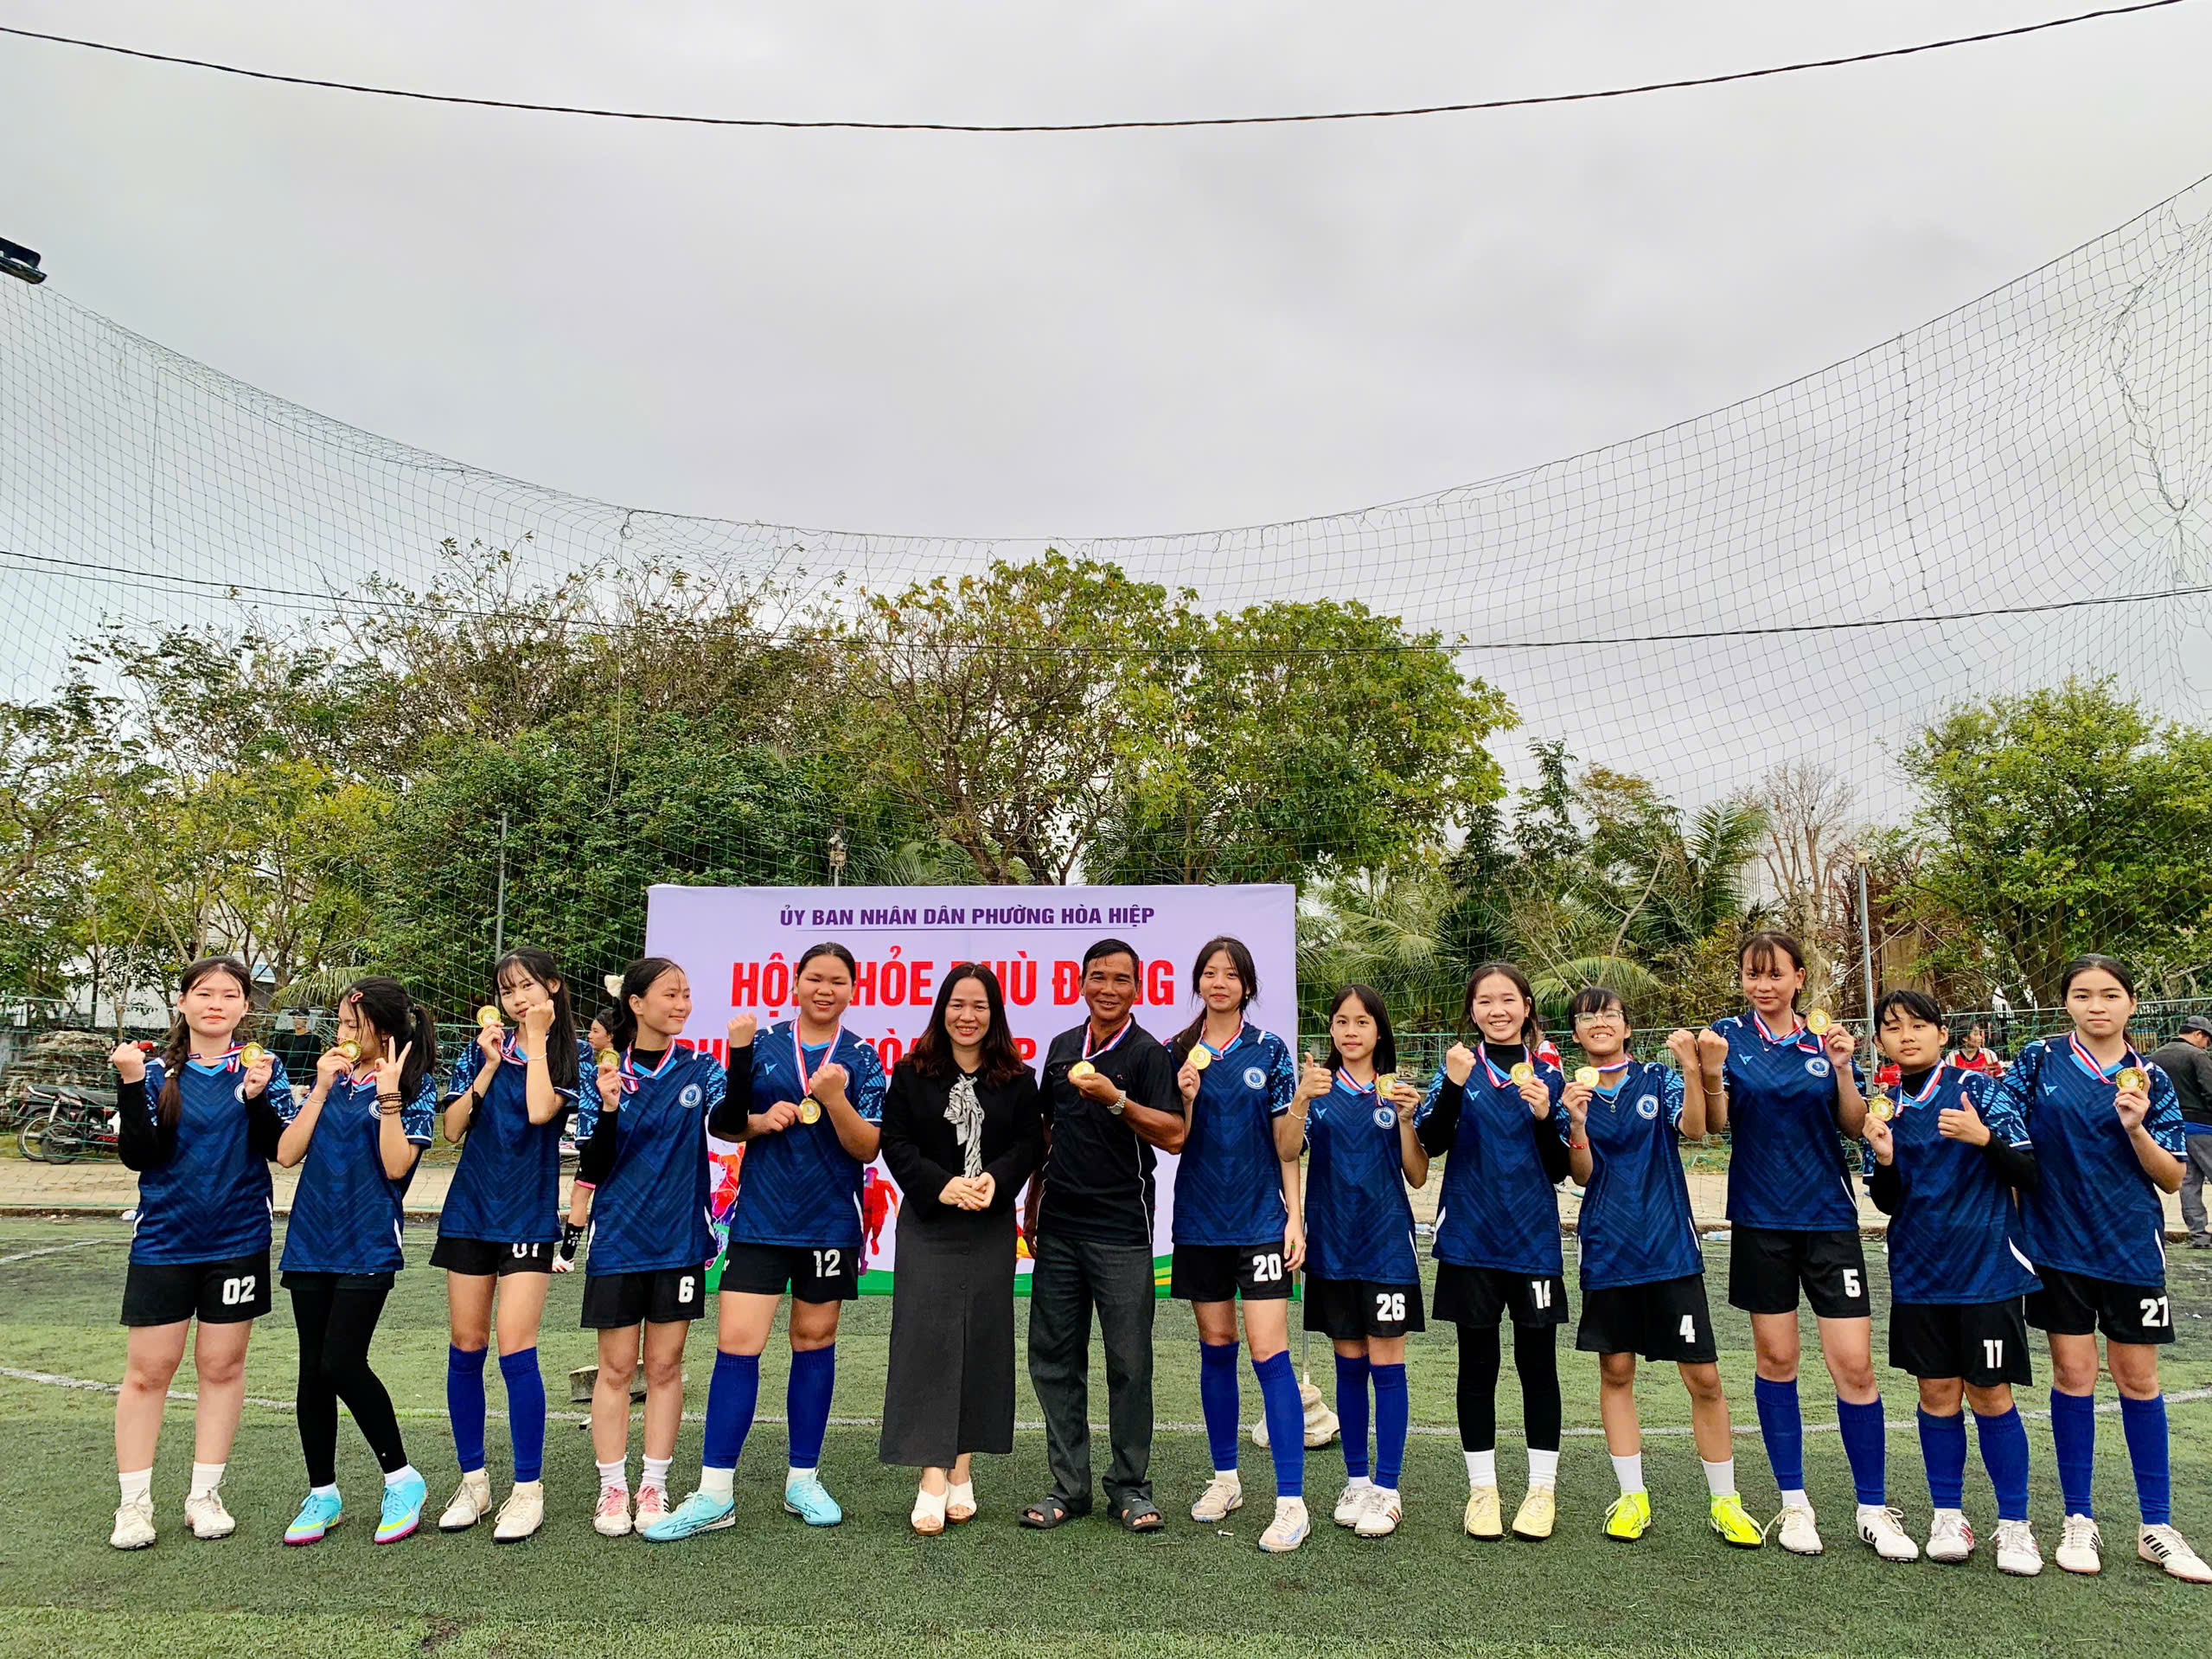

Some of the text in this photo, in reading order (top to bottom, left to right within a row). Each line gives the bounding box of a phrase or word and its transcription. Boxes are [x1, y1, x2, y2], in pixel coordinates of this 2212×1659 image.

[780, 905, 1155, 926] ỦY BAN NHÂN DÂN PHƯỜNG HÒA HIỆP
[849, 945, 934, 1006] HỎE
[813, 1249, 841, 1278] 12
[1252, 1252, 1282, 1282] 20
[221, 1275, 256, 1305] 02
[678, 1276, 695, 1304] 6
[1842, 1269, 1862, 1297] 5
[1376, 1293, 1406, 1322] 26
[2139, 1295, 2170, 1327] 27
[1679, 1314, 1696, 1343] 4
[1983, 1339, 2004, 1369] 11
